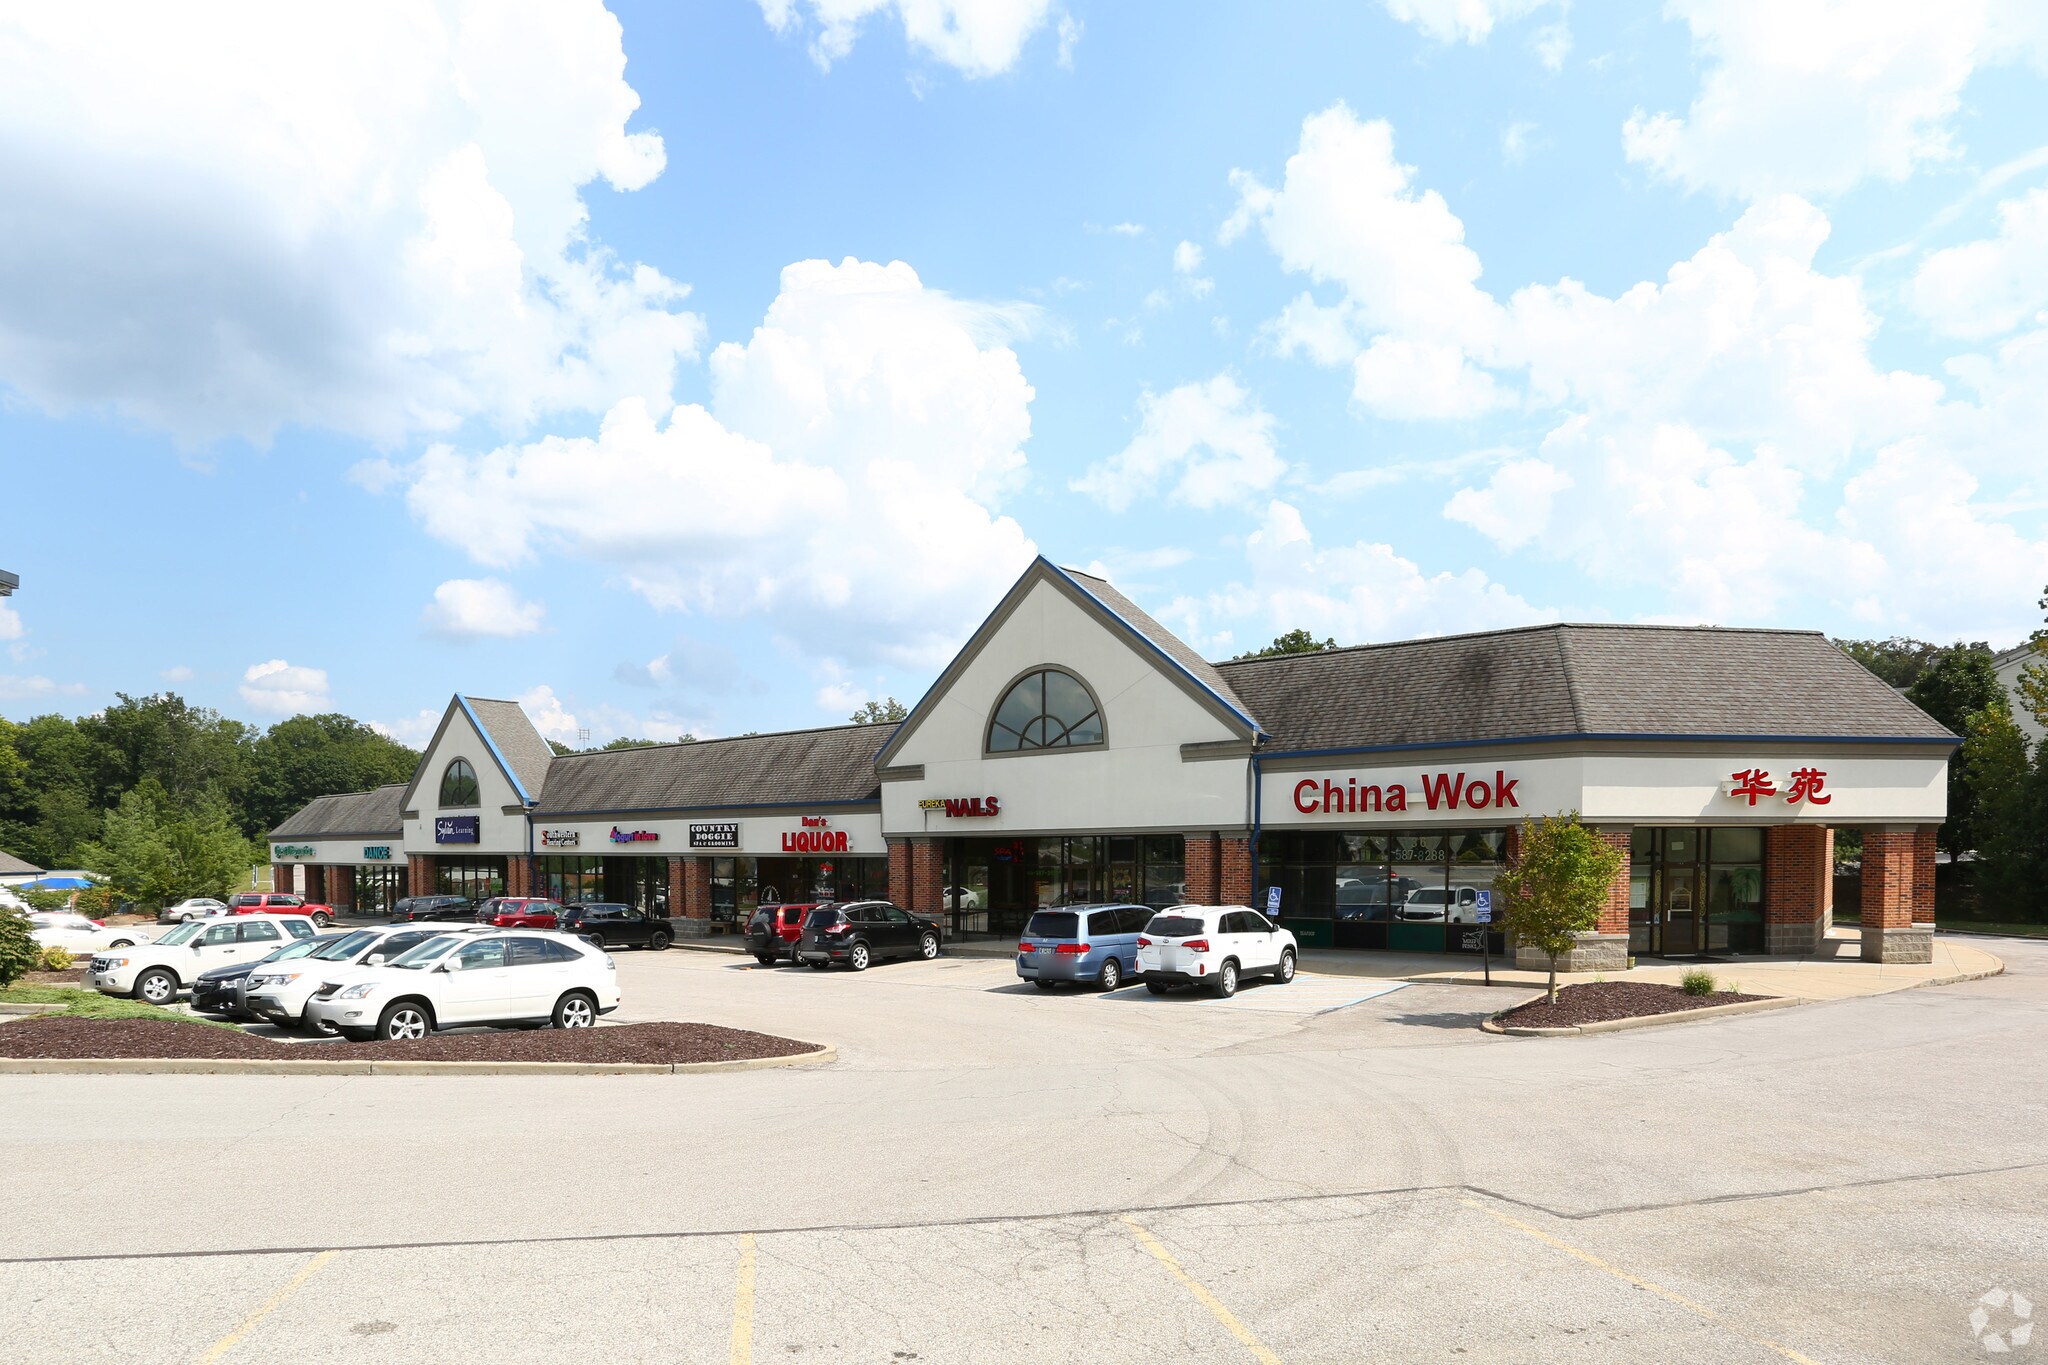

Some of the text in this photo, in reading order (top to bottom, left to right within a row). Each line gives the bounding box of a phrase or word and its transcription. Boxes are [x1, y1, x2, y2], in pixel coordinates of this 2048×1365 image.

[1293, 769, 1520, 814] China Wok
[1731, 768, 1831, 806] 华苑
[918, 796, 999, 818] EUREKA NAILS
[801, 816, 827, 827] Dan's
[455, 826, 474, 835] Learning
[690, 824, 737, 833] COUNTRY
[695, 833, 733, 841] DOGGIE
[781, 831, 848, 853] LIQUOR
[363, 846, 389, 859] DANCE
[1394, 849, 1445, 861] 587-8288
